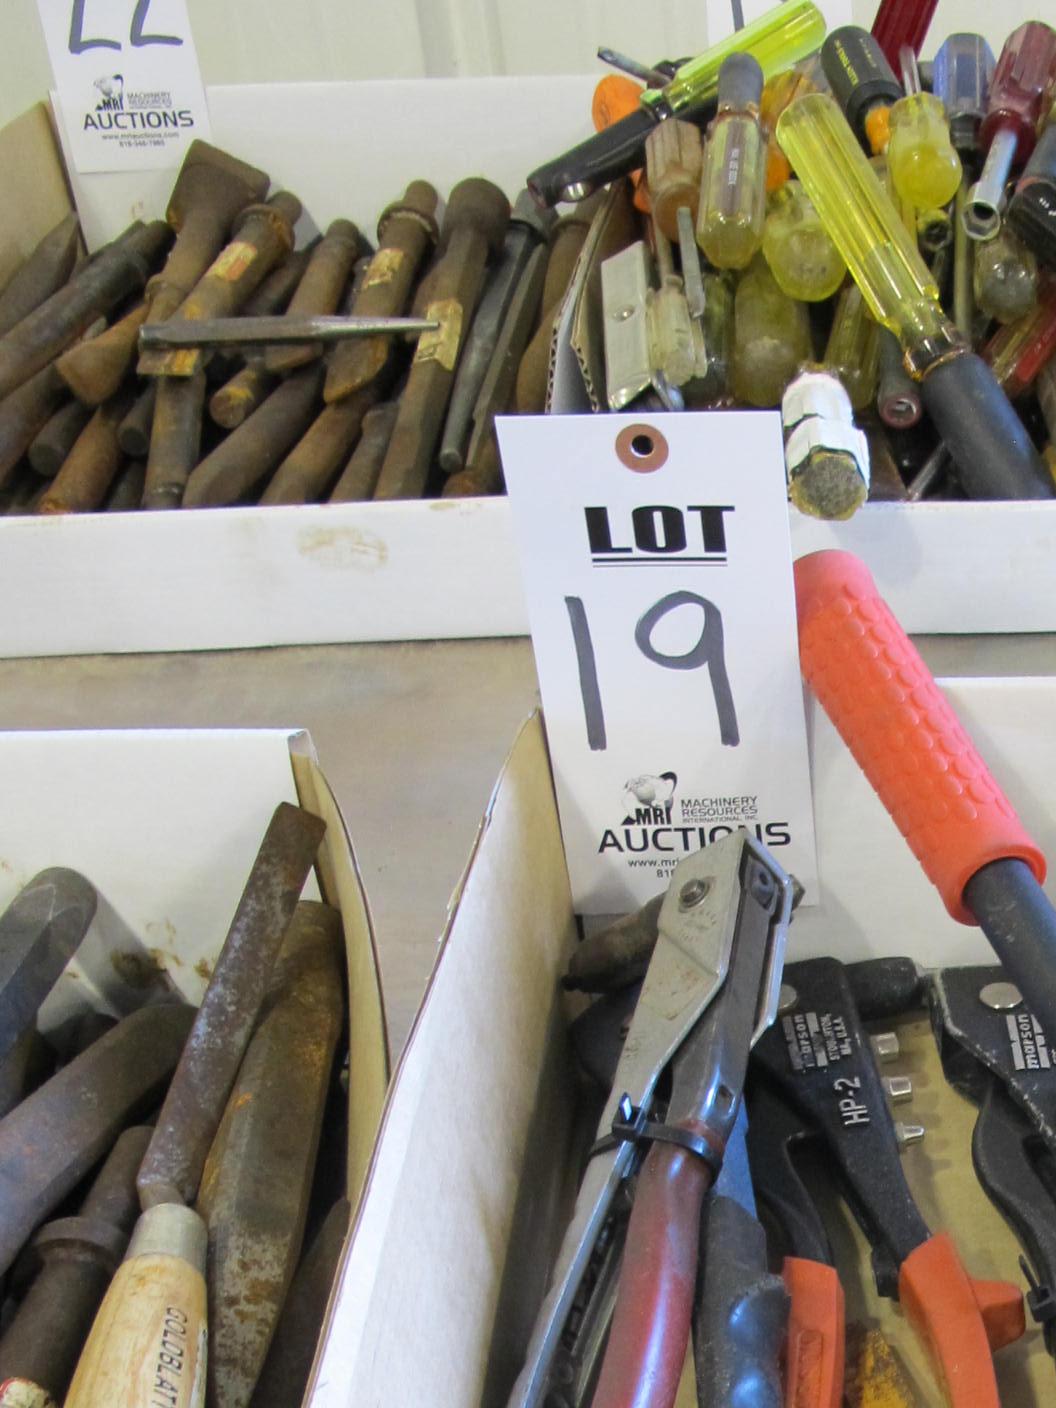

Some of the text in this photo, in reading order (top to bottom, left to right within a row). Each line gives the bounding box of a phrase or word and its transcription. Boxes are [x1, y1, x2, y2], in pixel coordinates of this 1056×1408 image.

[84, 110, 194, 130] AUCTIONS
[584, 505, 735, 554] LOT
[564, 590, 740, 751] 19
[635, 807, 673, 825] MRI
[681, 796, 758, 808] MACHINERY
[682, 805, 758, 817] RESOURCES
[1017, 1014, 1040, 1069] marson
[833, 1076, 870, 1125] HP-2
